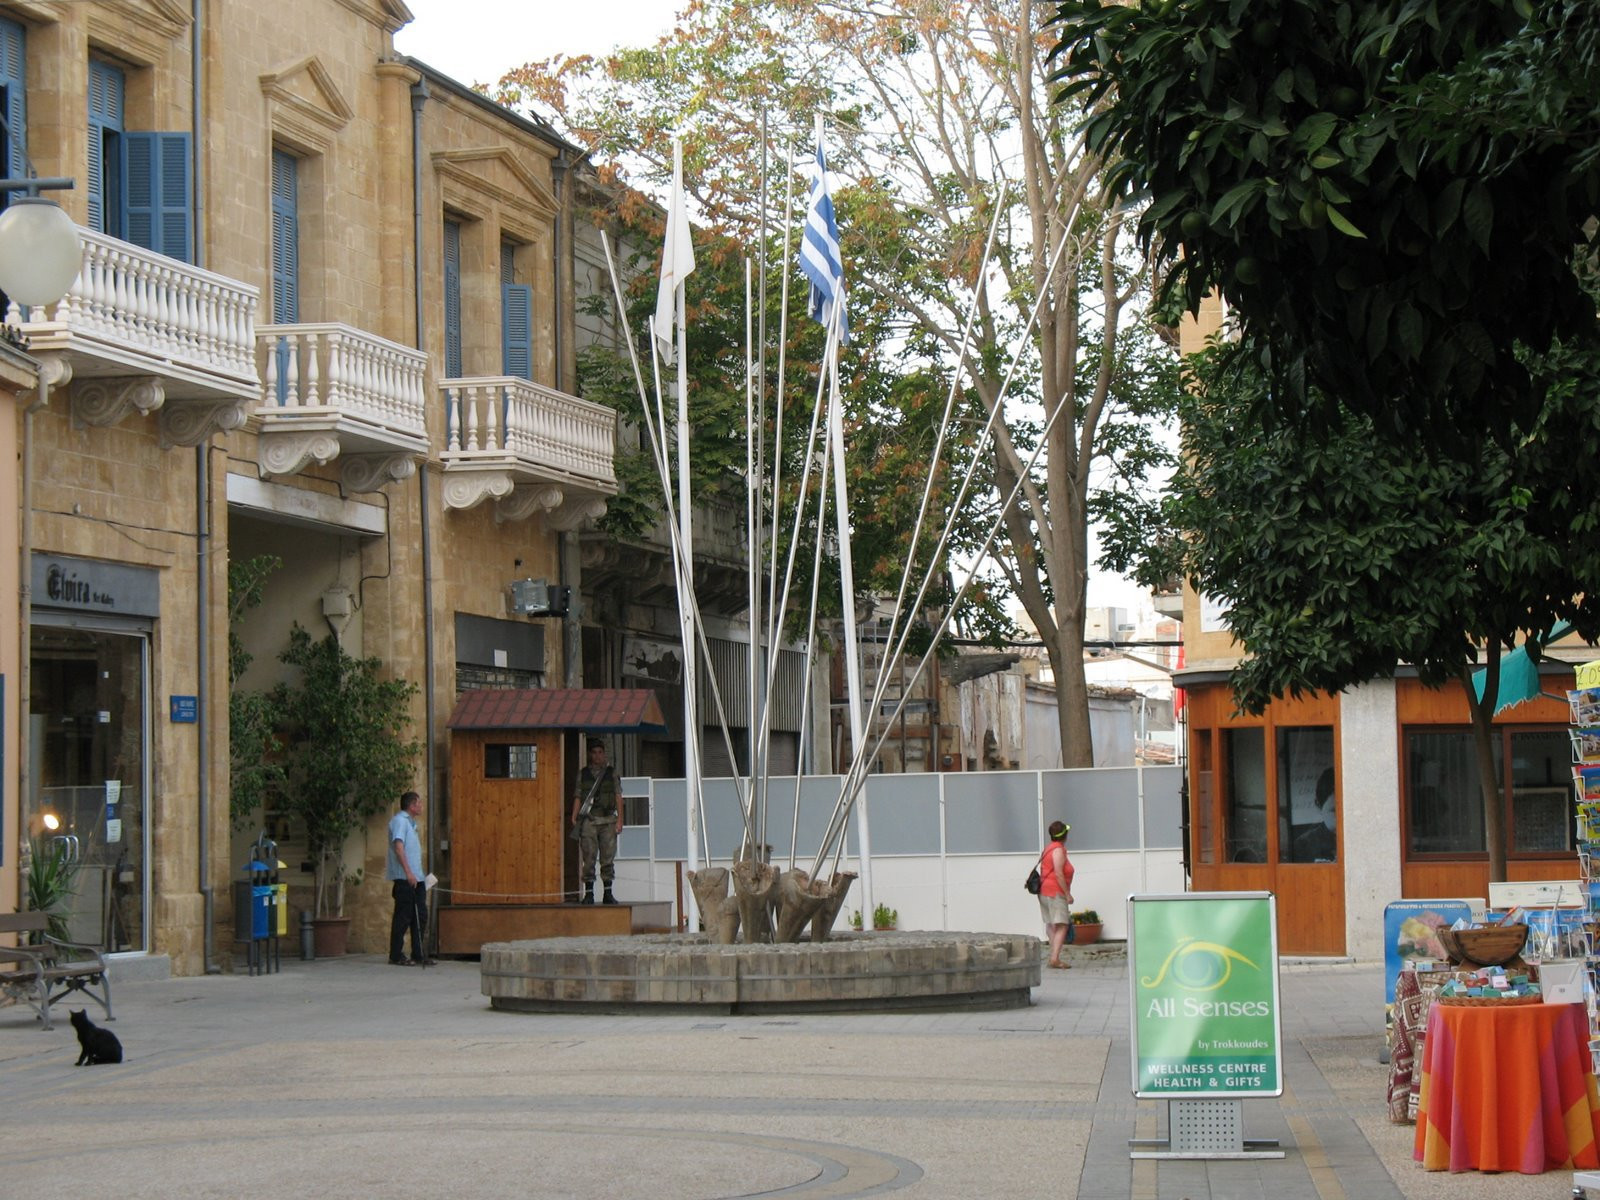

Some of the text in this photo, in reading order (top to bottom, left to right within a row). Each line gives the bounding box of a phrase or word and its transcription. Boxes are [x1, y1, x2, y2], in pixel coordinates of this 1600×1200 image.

[1146, 997, 1270, 1018] All Senses
[1198, 1040, 1269, 1052] by Trokkoudes
[1147, 1063, 1267, 1075] WELLNESS CENTRE
[1153, 1076, 1261, 1088] HEALTH & GIFTS
